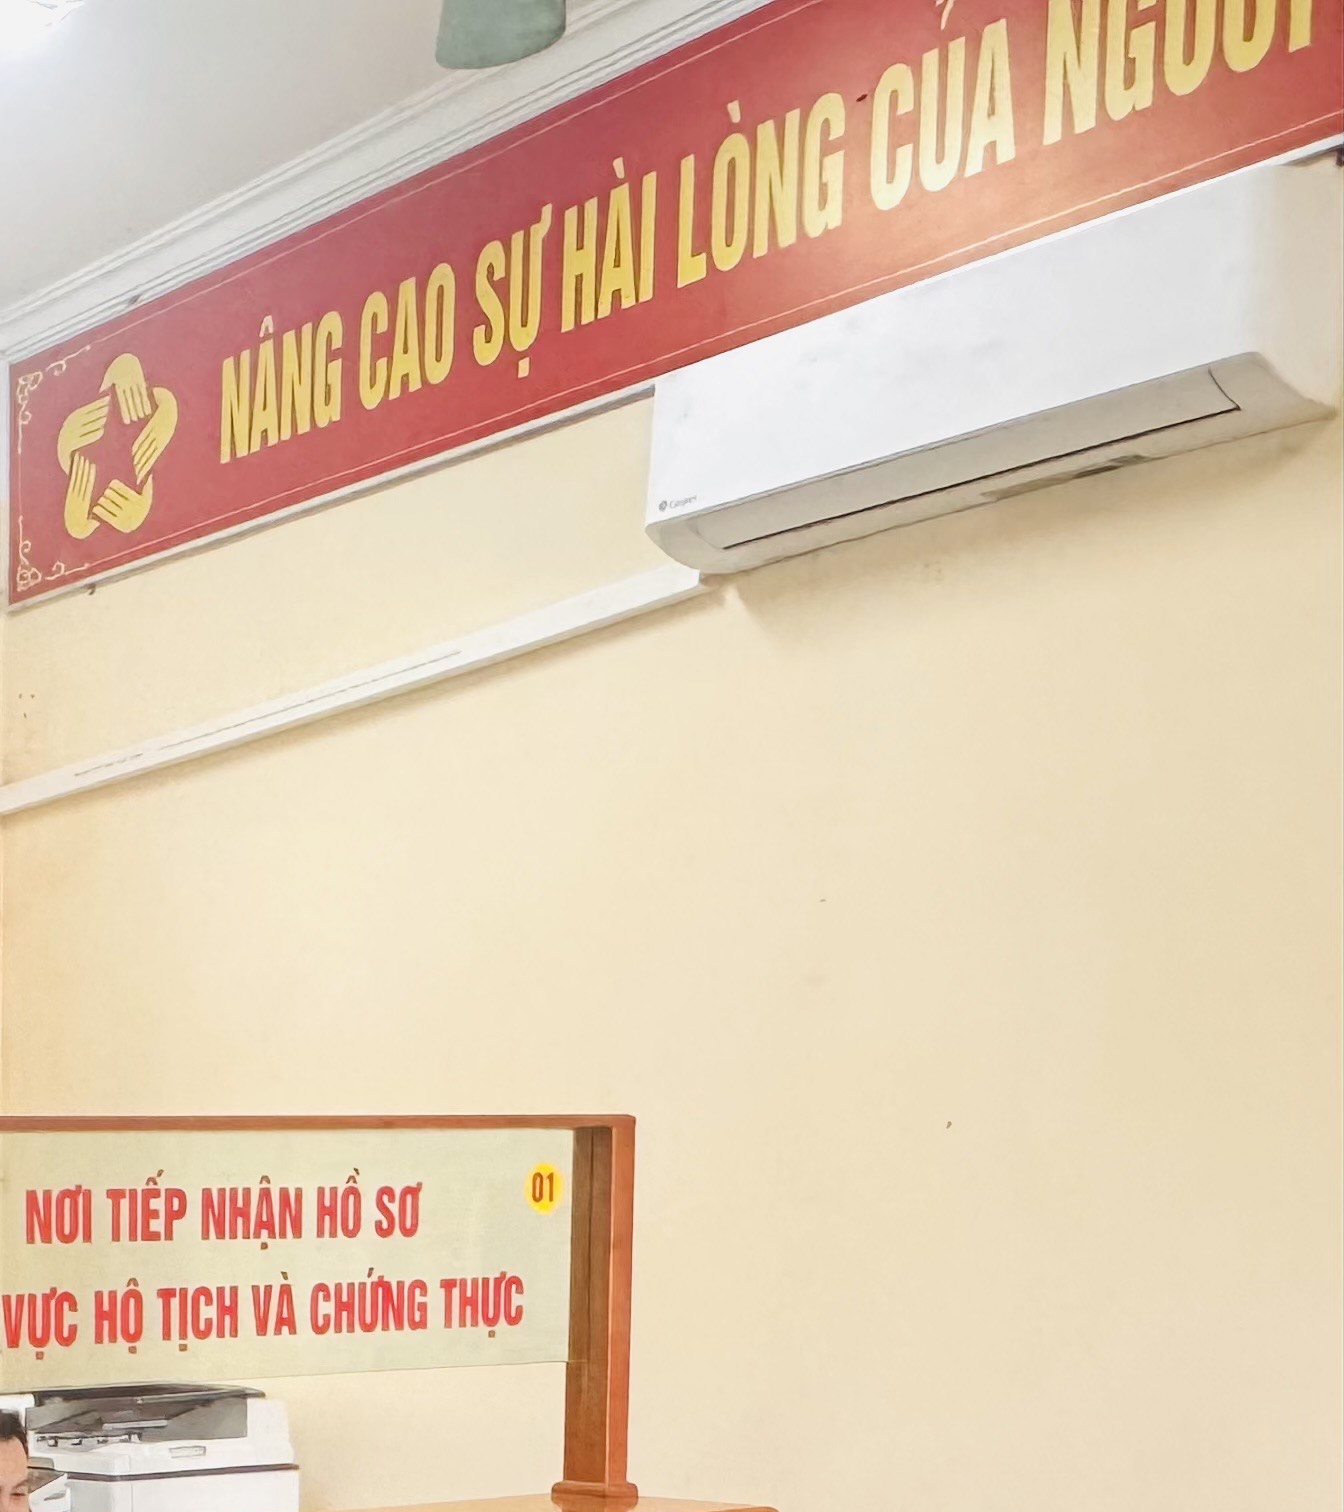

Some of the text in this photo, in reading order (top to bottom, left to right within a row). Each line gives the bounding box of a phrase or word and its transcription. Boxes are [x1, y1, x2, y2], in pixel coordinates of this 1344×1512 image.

[219, 312, 344, 464] NÂNG
[358, 262, 456, 410] CAO
[472, 203, 552, 378] SỰ
[560, 156, 658, 333] HÀI
[676, 92, 845, 289] LÒNG
[26, 1167, 424, 1250] NƠI TIẾP NHẬN HỒ SƠ
[530, 1171, 556, 1205] 01
[2, 1288, 79, 1360] VỰC
[94, 1277, 143, 1361] HỘ
[157, 1287, 239, 1352] TỊCH
[251, 1271, 297, 1337] VÀ
[310, 1267, 429, 1335] CHỨNG
[440, 1272, 525, 1338] THỰC
